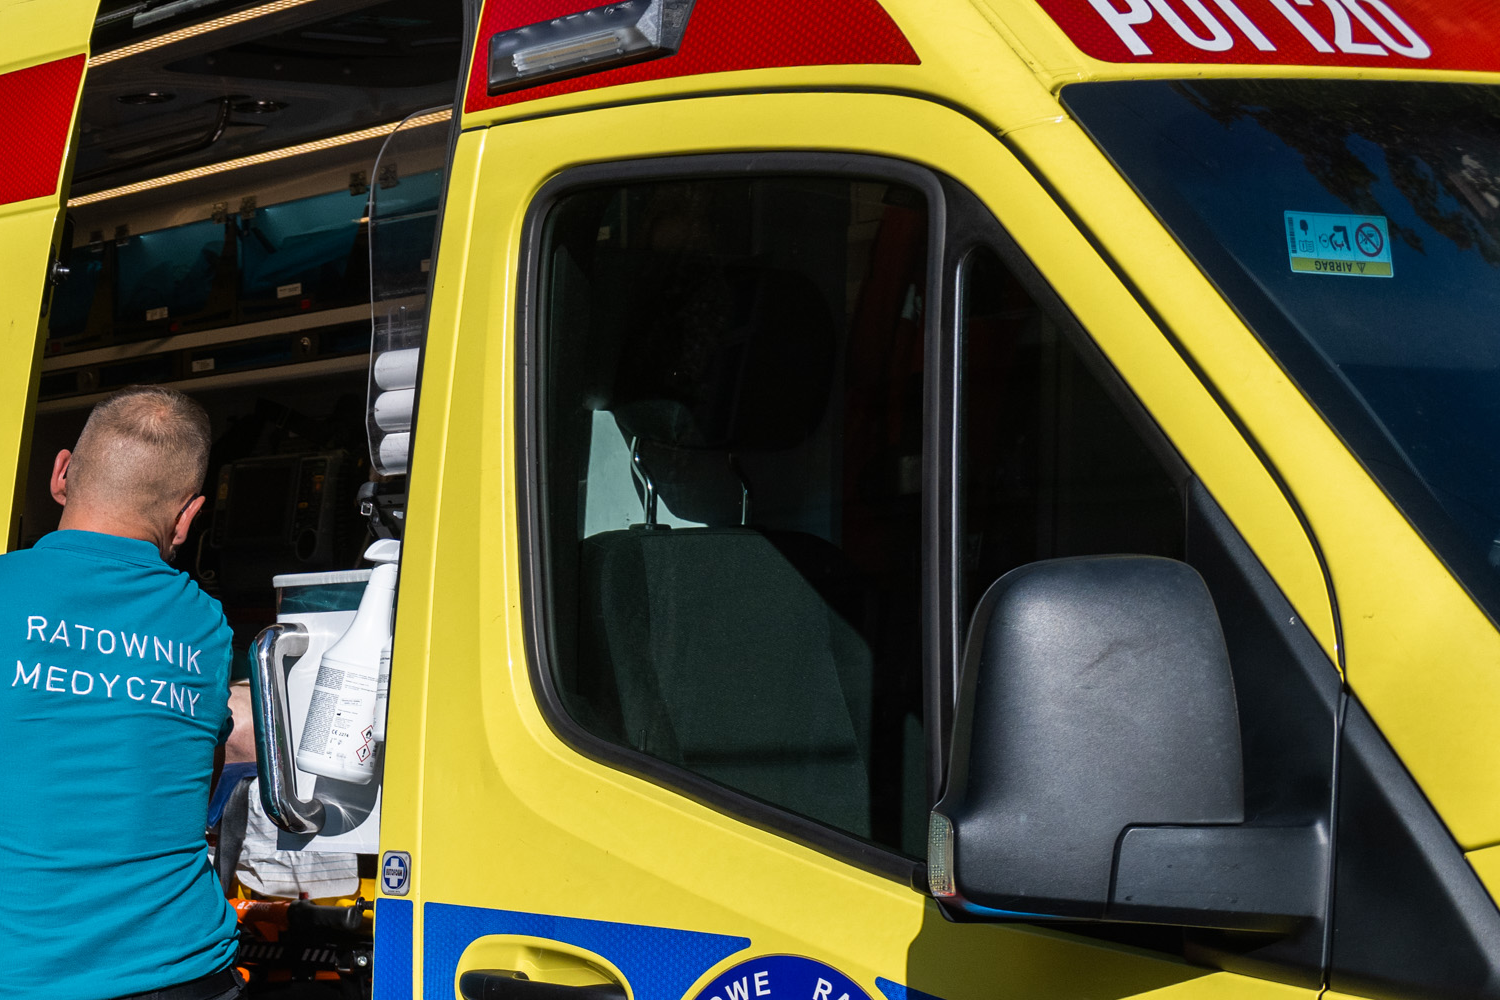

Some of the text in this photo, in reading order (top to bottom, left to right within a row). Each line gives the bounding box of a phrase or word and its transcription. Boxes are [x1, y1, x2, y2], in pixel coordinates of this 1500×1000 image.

[1314, 260, 1353, 272] AIRBAG
[26, 615, 202, 675] RATOWNIK
[11, 660, 201, 717] MEDYCZNY
